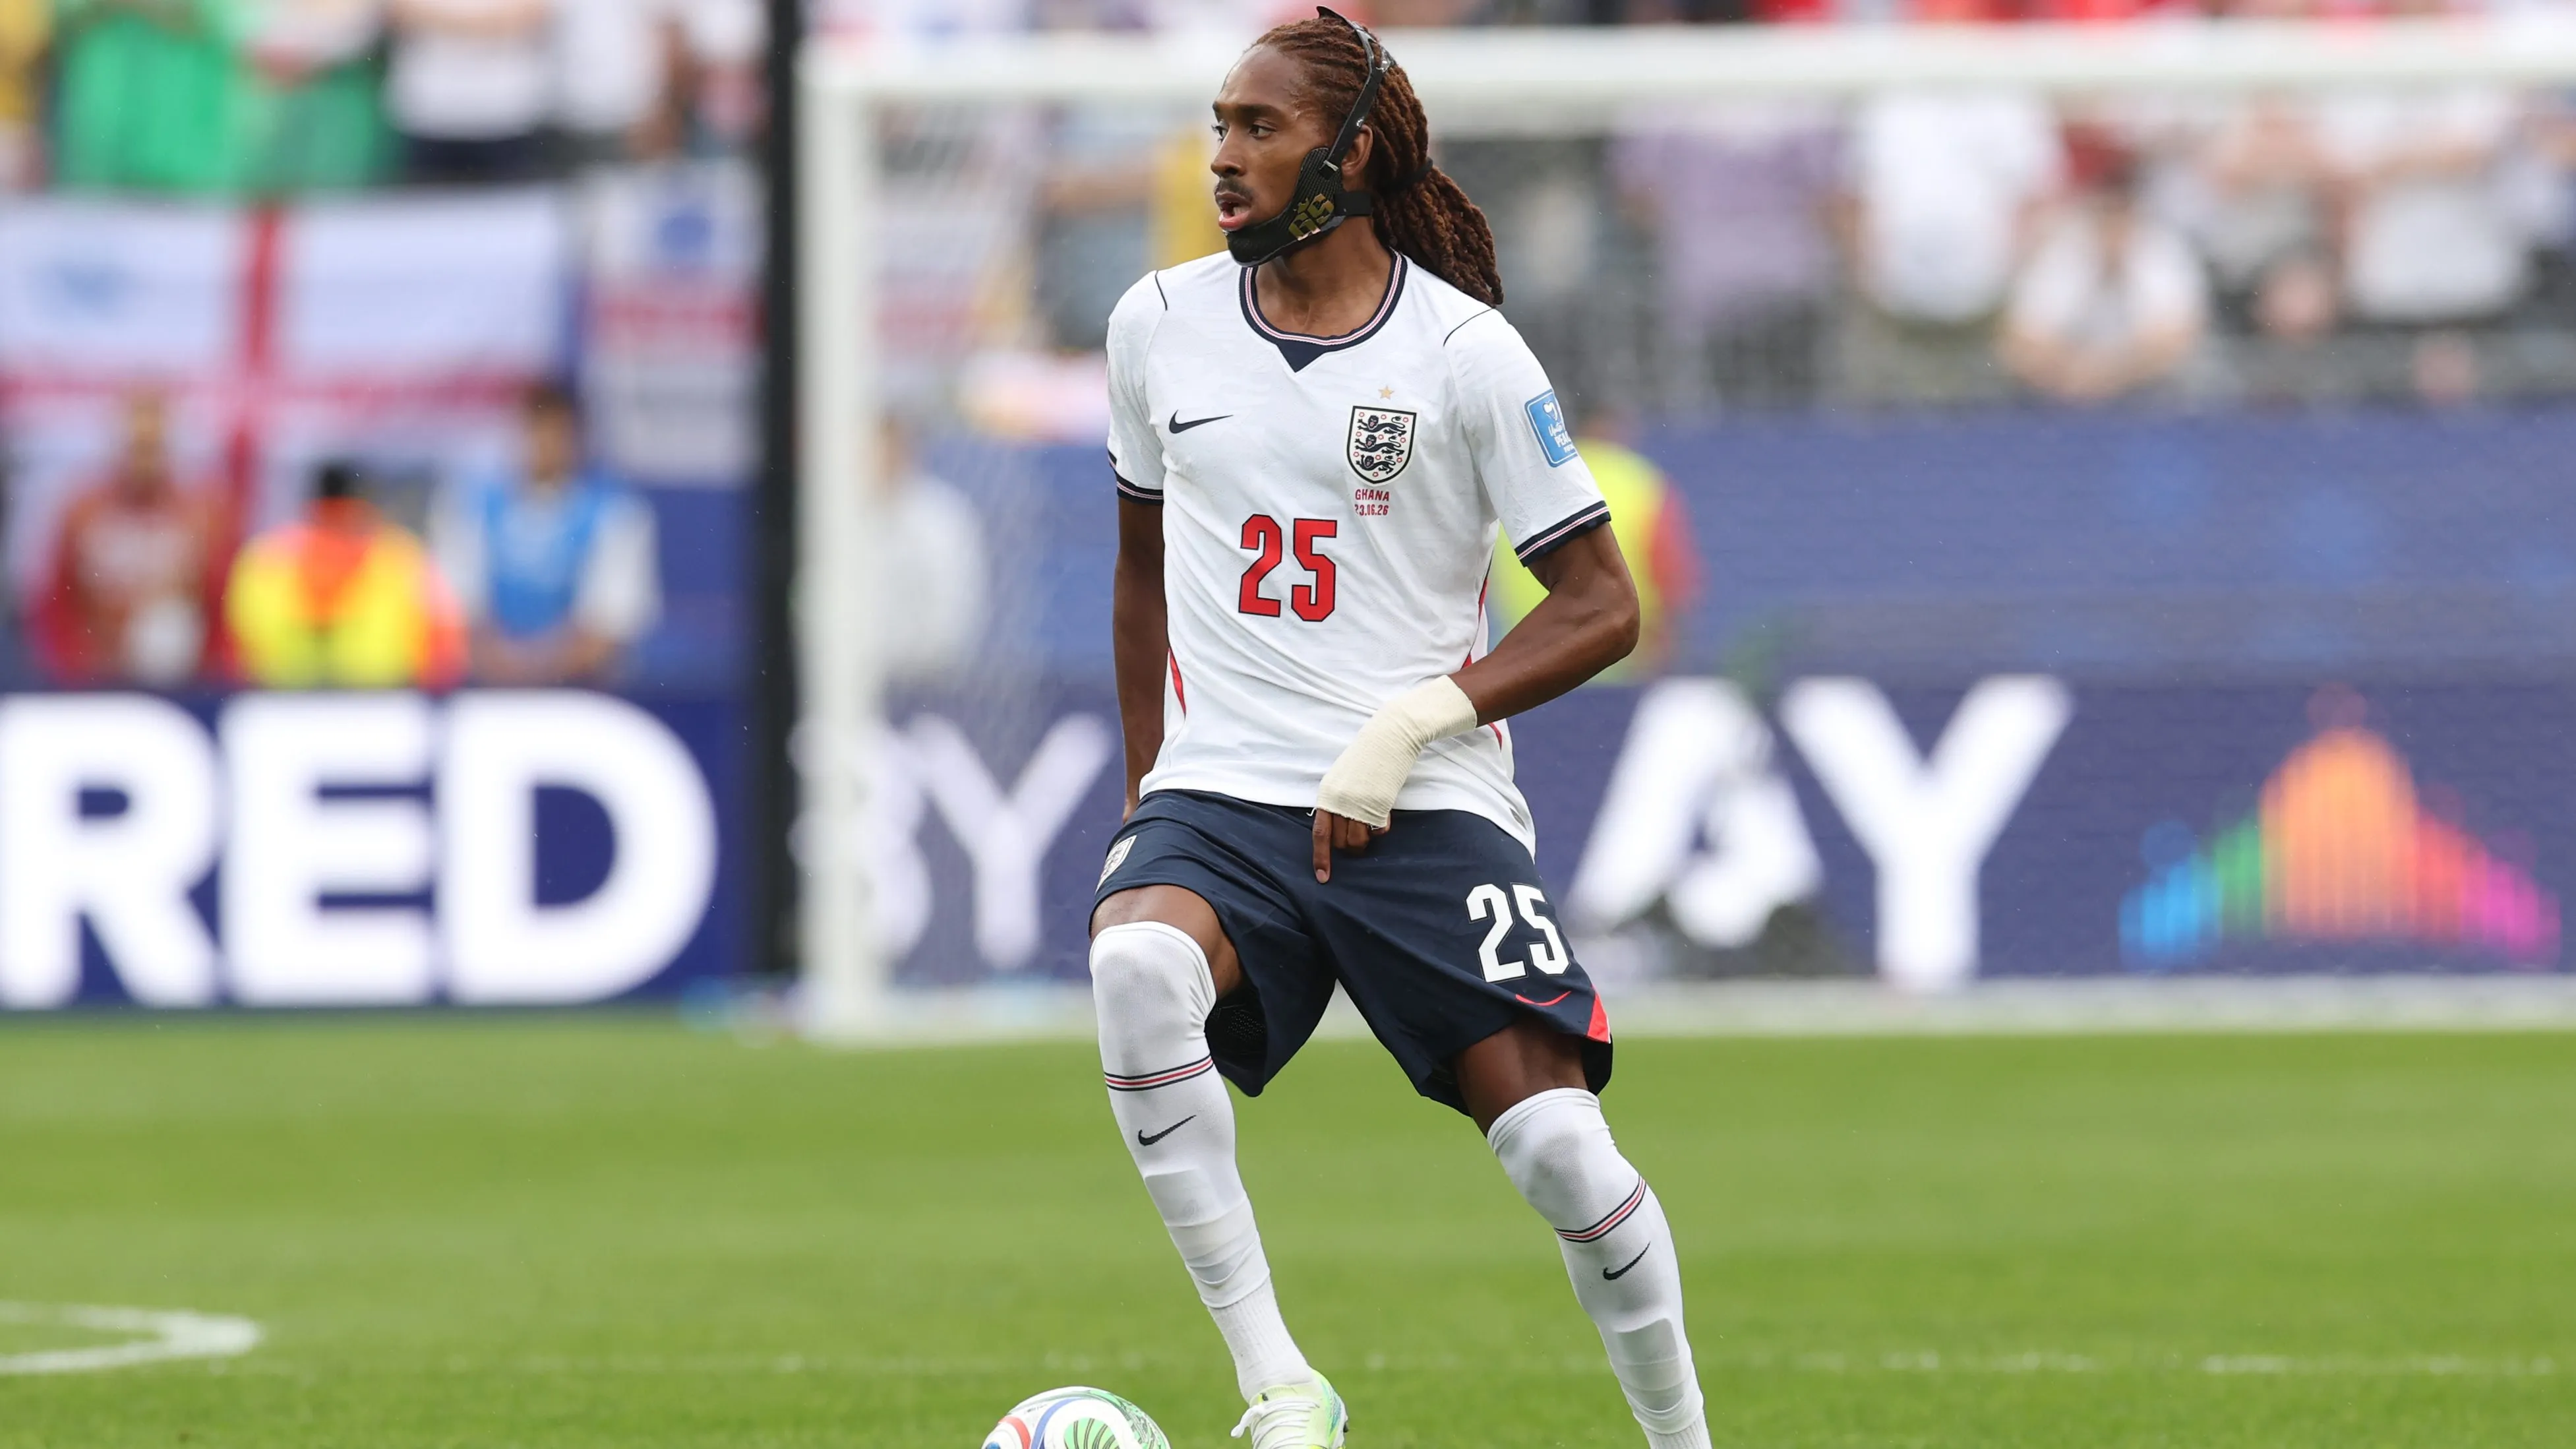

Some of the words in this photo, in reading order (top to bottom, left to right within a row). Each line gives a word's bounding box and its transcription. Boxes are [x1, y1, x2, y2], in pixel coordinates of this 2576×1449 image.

[1354, 488, 1390, 501] GHANA
[1354, 504, 1389, 516] 23.06.26
[1238, 513, 1338, 623] 25
[1464, 882, 1571, 983] 25
